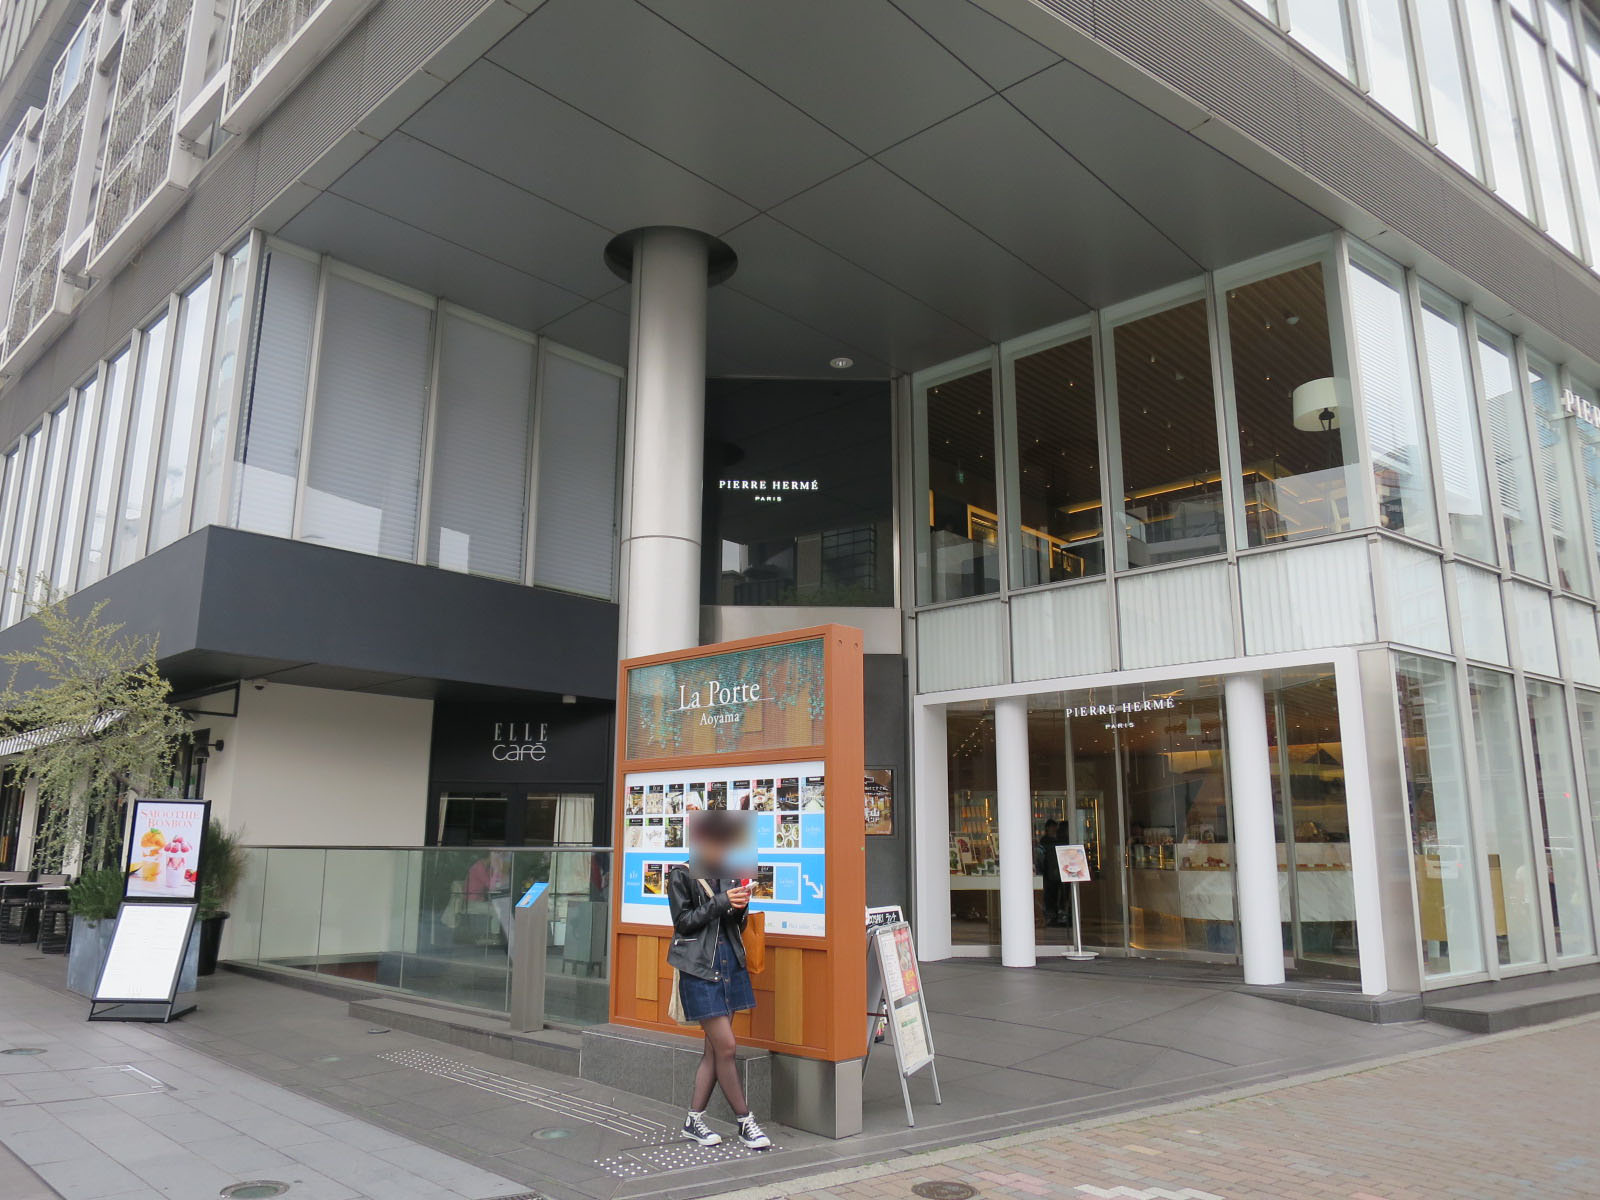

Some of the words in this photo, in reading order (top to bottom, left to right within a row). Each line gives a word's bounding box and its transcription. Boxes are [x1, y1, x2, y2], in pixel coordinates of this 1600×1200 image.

[719, 480, 767, 490] PIERRE
[772, 480, 819, 490] HERMÉ
[680, 684, 700, 709] La
[709, 680, 760, 706] Porte
[1066, 704, 1117, 718] PIERRE
[1122, 696, 1175, 713] HERMÉ
[700, 713, 740, 728] Aoyama
[1105, 722, 1135, 730] PARIS
[494, 722, 548, 741] ELLE
